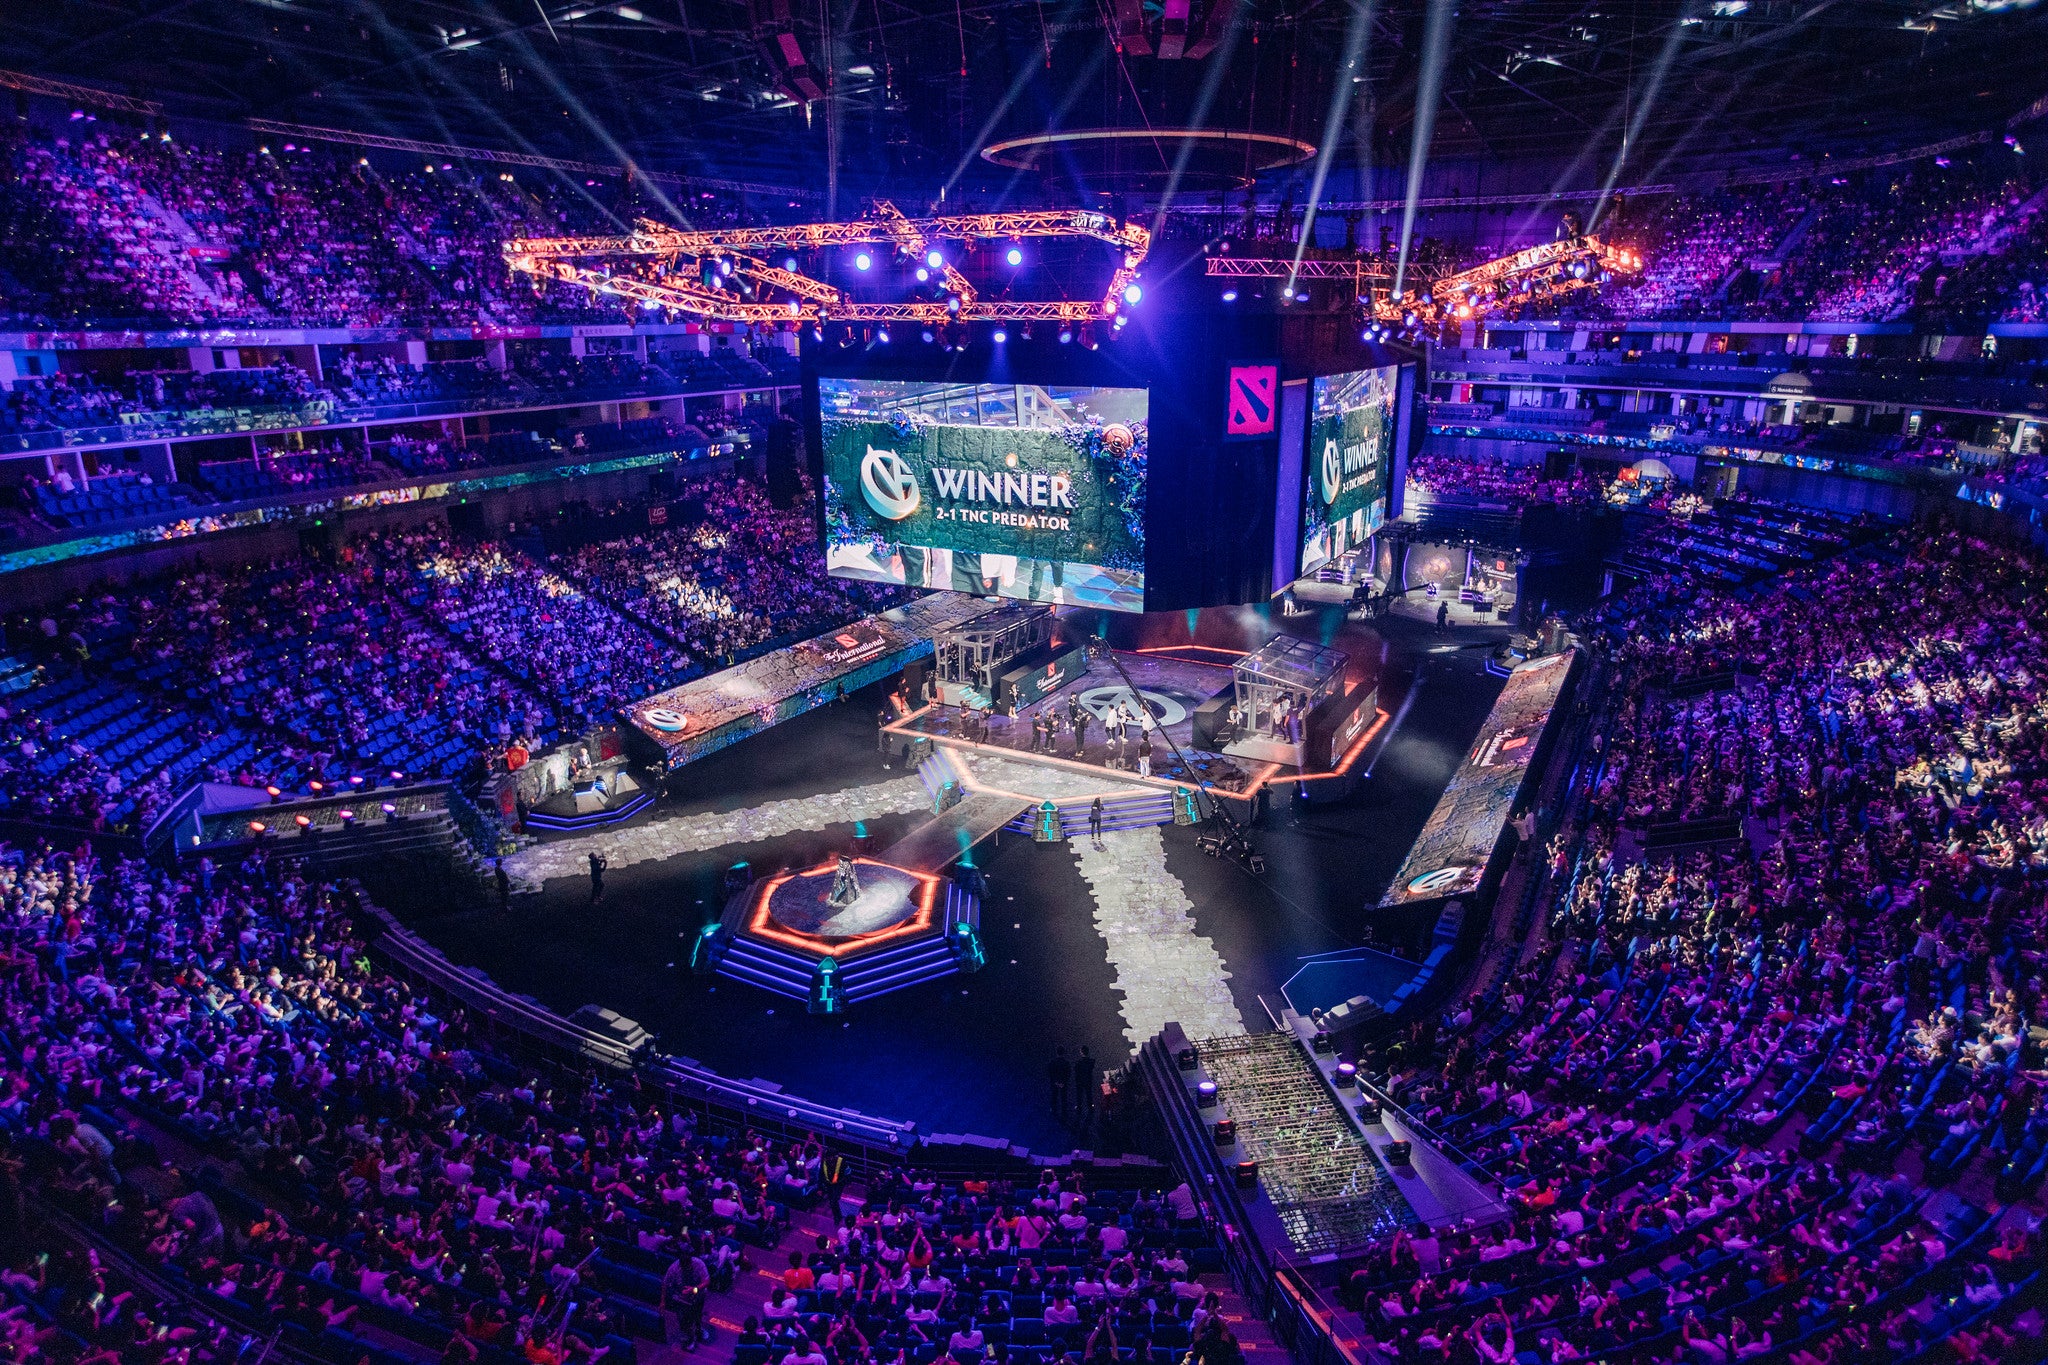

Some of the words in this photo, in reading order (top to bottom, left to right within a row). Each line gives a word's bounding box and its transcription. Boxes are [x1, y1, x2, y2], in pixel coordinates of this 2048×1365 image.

[1344, 438, 1378, 474] WINNER
[931, 467, 1074, 509] WINNER
[936, 507, 957, 520] 2-1
[960, 509, 989, 523] TNC
[992, 510, 1070, 530] PREDATOR
[833, 635, 885, 662] International
